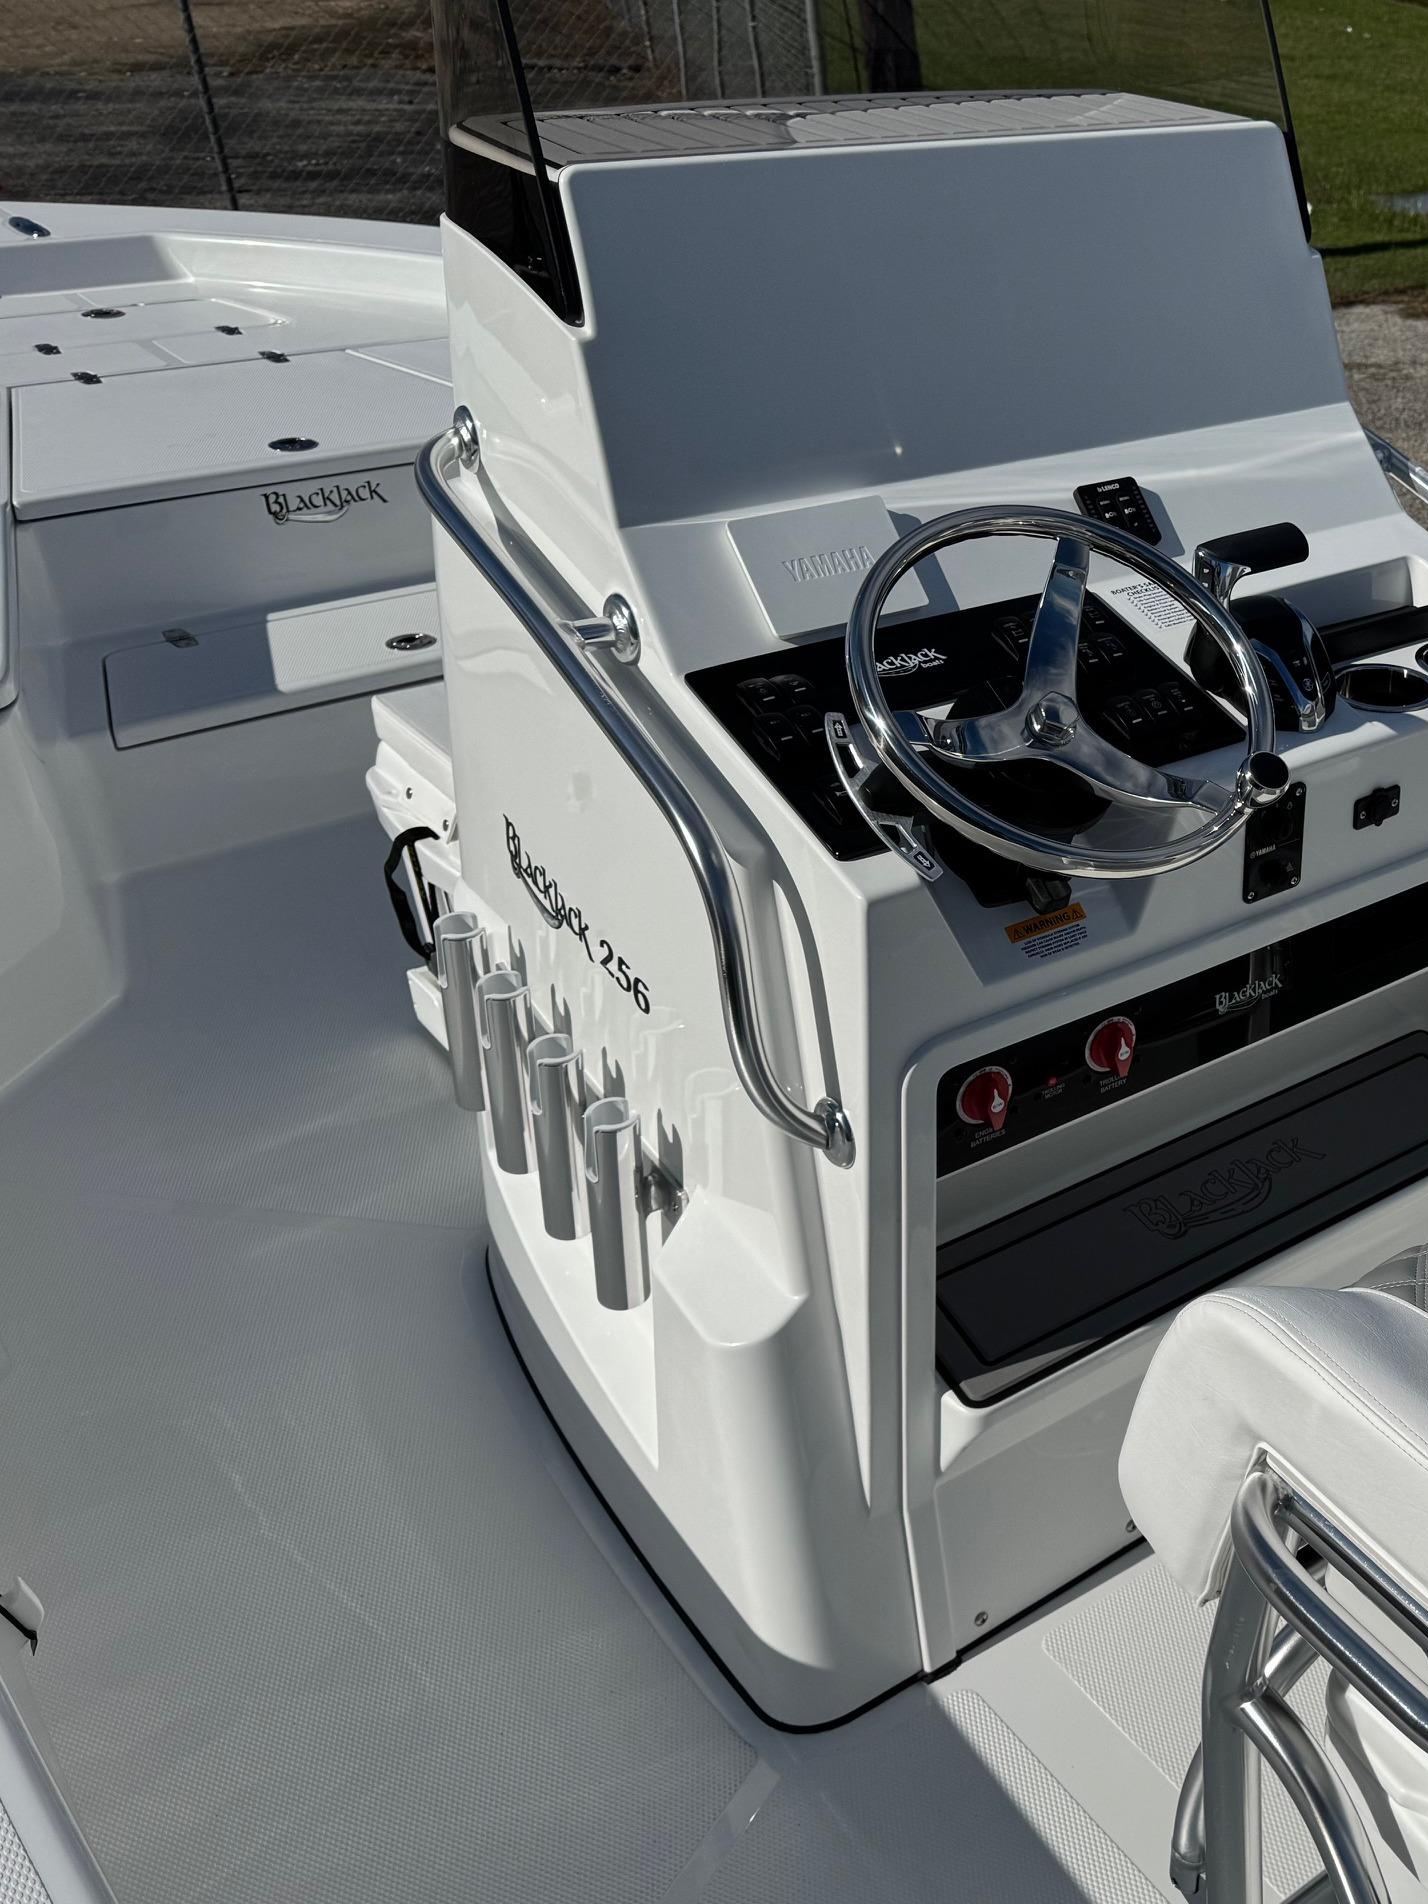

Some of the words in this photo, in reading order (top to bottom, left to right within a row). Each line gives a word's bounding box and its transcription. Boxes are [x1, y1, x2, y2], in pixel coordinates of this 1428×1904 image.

[1101, 483, 1120, 492] LENCO
[781, 545, 877, 582] YAMAHA
[1111, 583, 1144, 595] BOATER'S
[1127, 585, 1160, 597] CHECKLIS
[875, 648, 948, 672] ackJack
[1256, 843, 1277, 857] YAMAHA
[1023, 911, 1071, 935] WARNING
[600, 939, 650, 1015] 256
[1100, 1078, 1127, 1093] BATTERY
[970, 1128, 1006, 1148] BATTERIES
